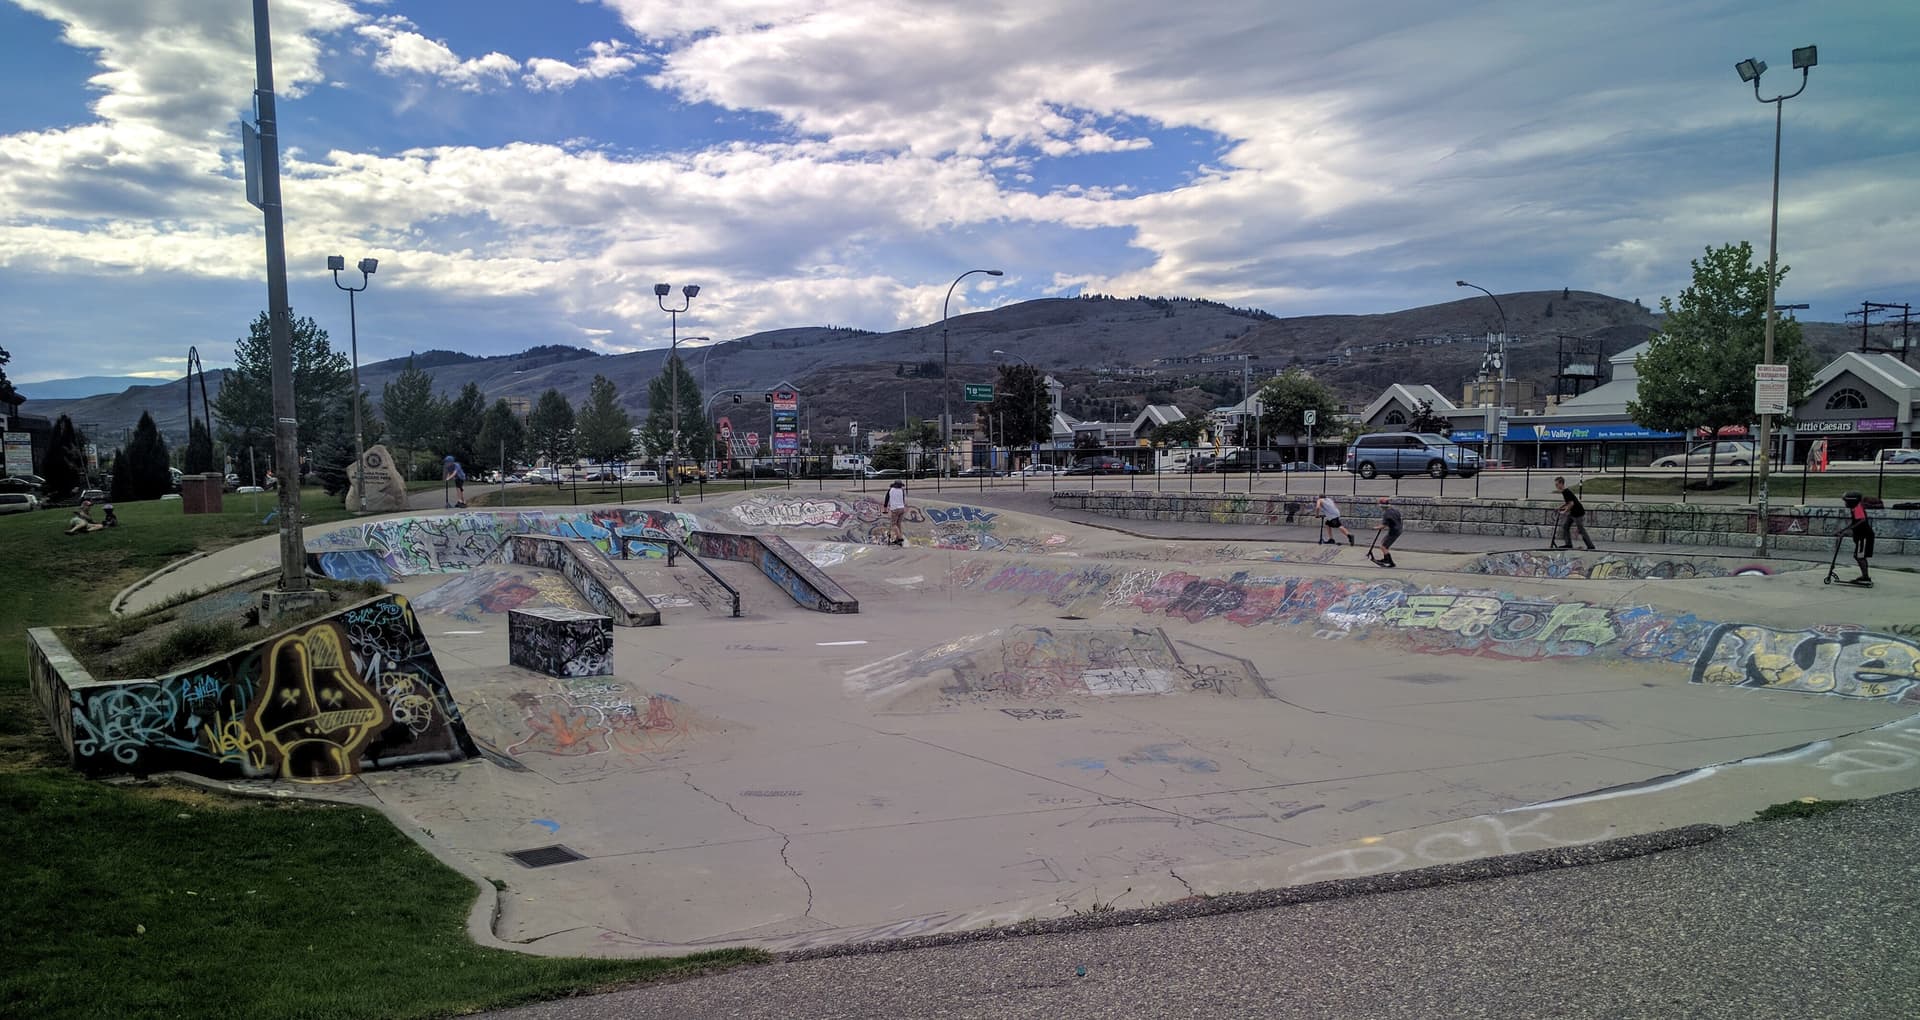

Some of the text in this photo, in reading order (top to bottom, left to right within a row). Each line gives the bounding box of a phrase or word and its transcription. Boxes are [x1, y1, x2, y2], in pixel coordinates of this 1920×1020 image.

[1796, 421, 1818, 431] Little
[1819, 421, 1852, 431] Caesars
[1551, 429, 1571, 439] Valley
